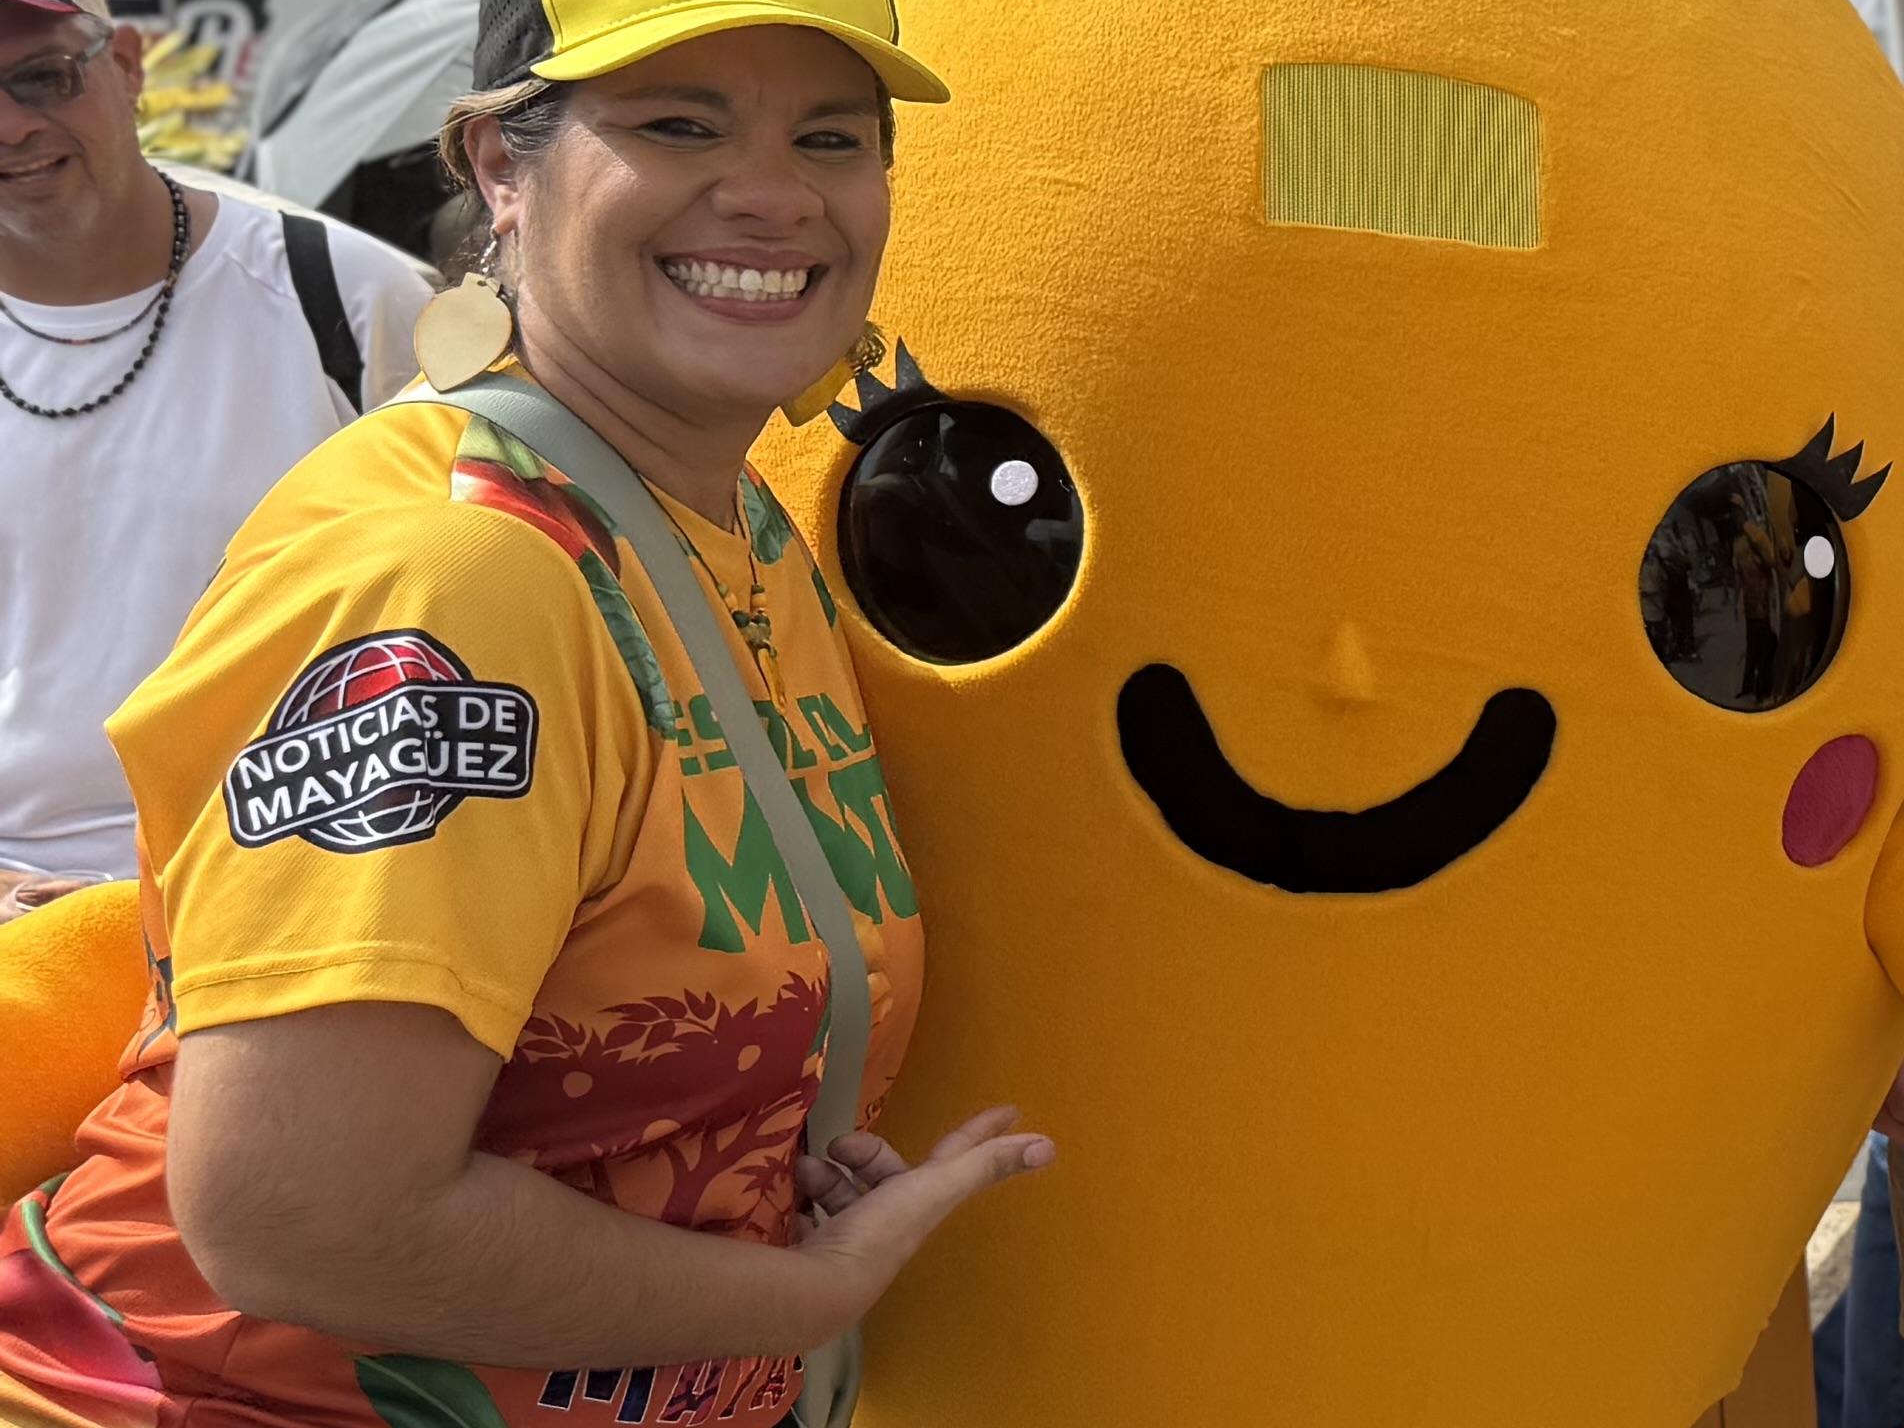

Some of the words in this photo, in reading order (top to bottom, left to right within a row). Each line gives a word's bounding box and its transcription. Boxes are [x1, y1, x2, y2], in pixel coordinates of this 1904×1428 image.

[237, 694, 439, 790] NOTICIAS
[457, 696, 518, 735] DE
[246, 730, 519, 833] MAYAGÜEZ
